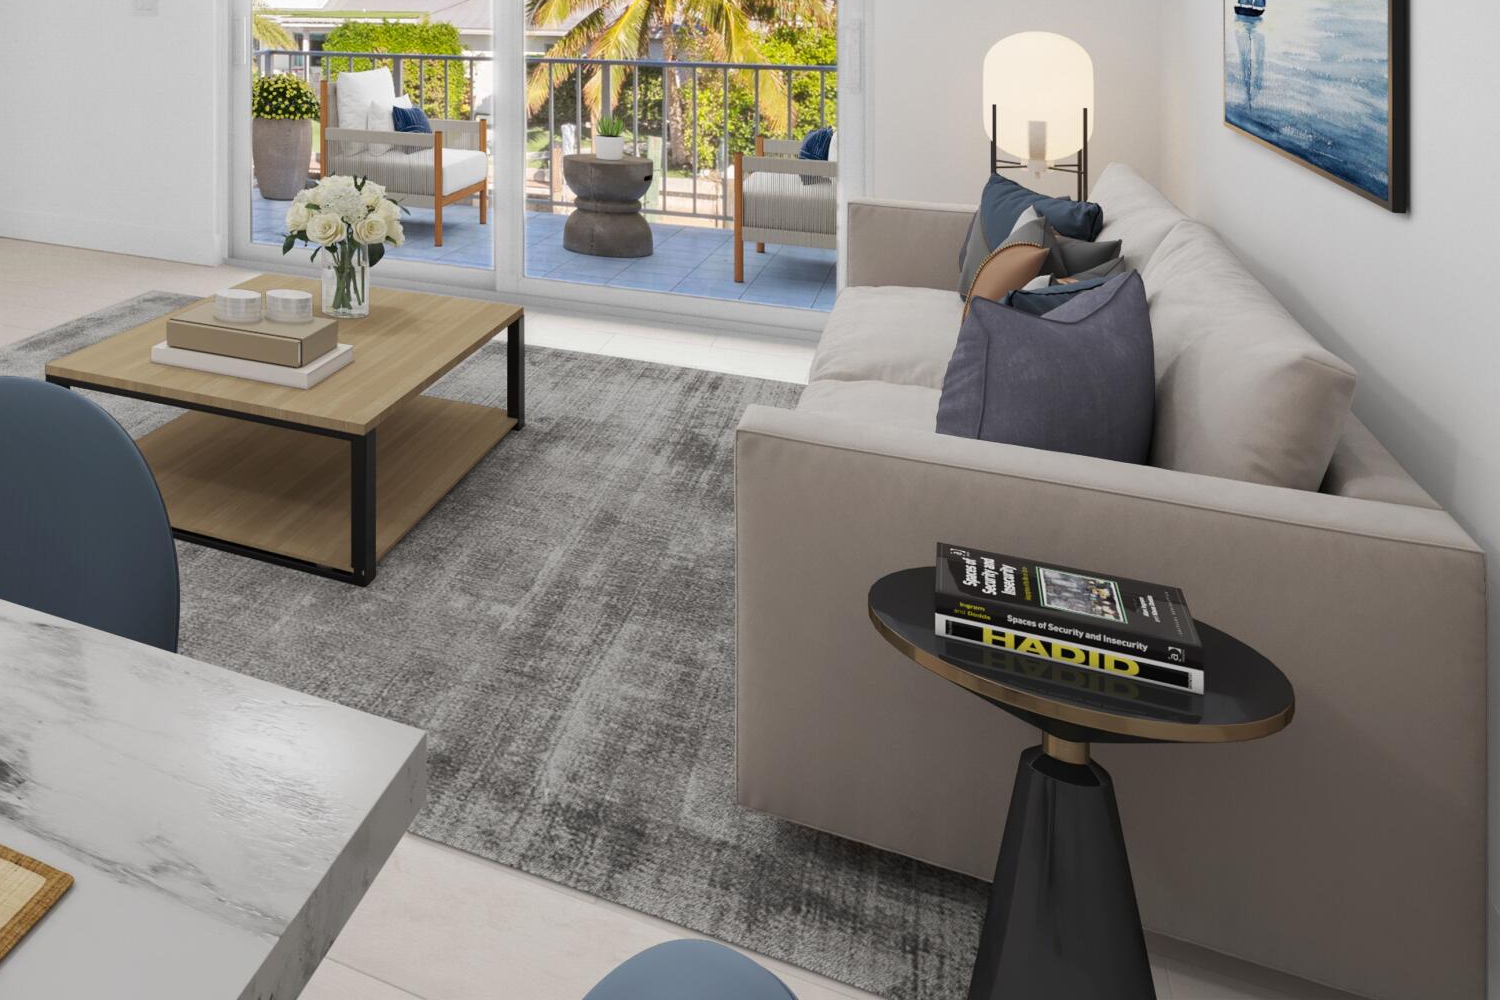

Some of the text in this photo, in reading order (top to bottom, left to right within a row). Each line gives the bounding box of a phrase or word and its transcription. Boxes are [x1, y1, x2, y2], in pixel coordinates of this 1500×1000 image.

[963, 565, 980, 587] Spaces
[980, 557, 999, 596] Security and
[1000, 564, 1017, 596] Insecurity
[982, 626, 1140, 677] HADID
[1007, 614, 1037, 627] Spaces
[1048, 623, 1085, 638] Security
[1085, 631, 1101, 641] and
[1103, 635, 1149, 652] Insecurity
